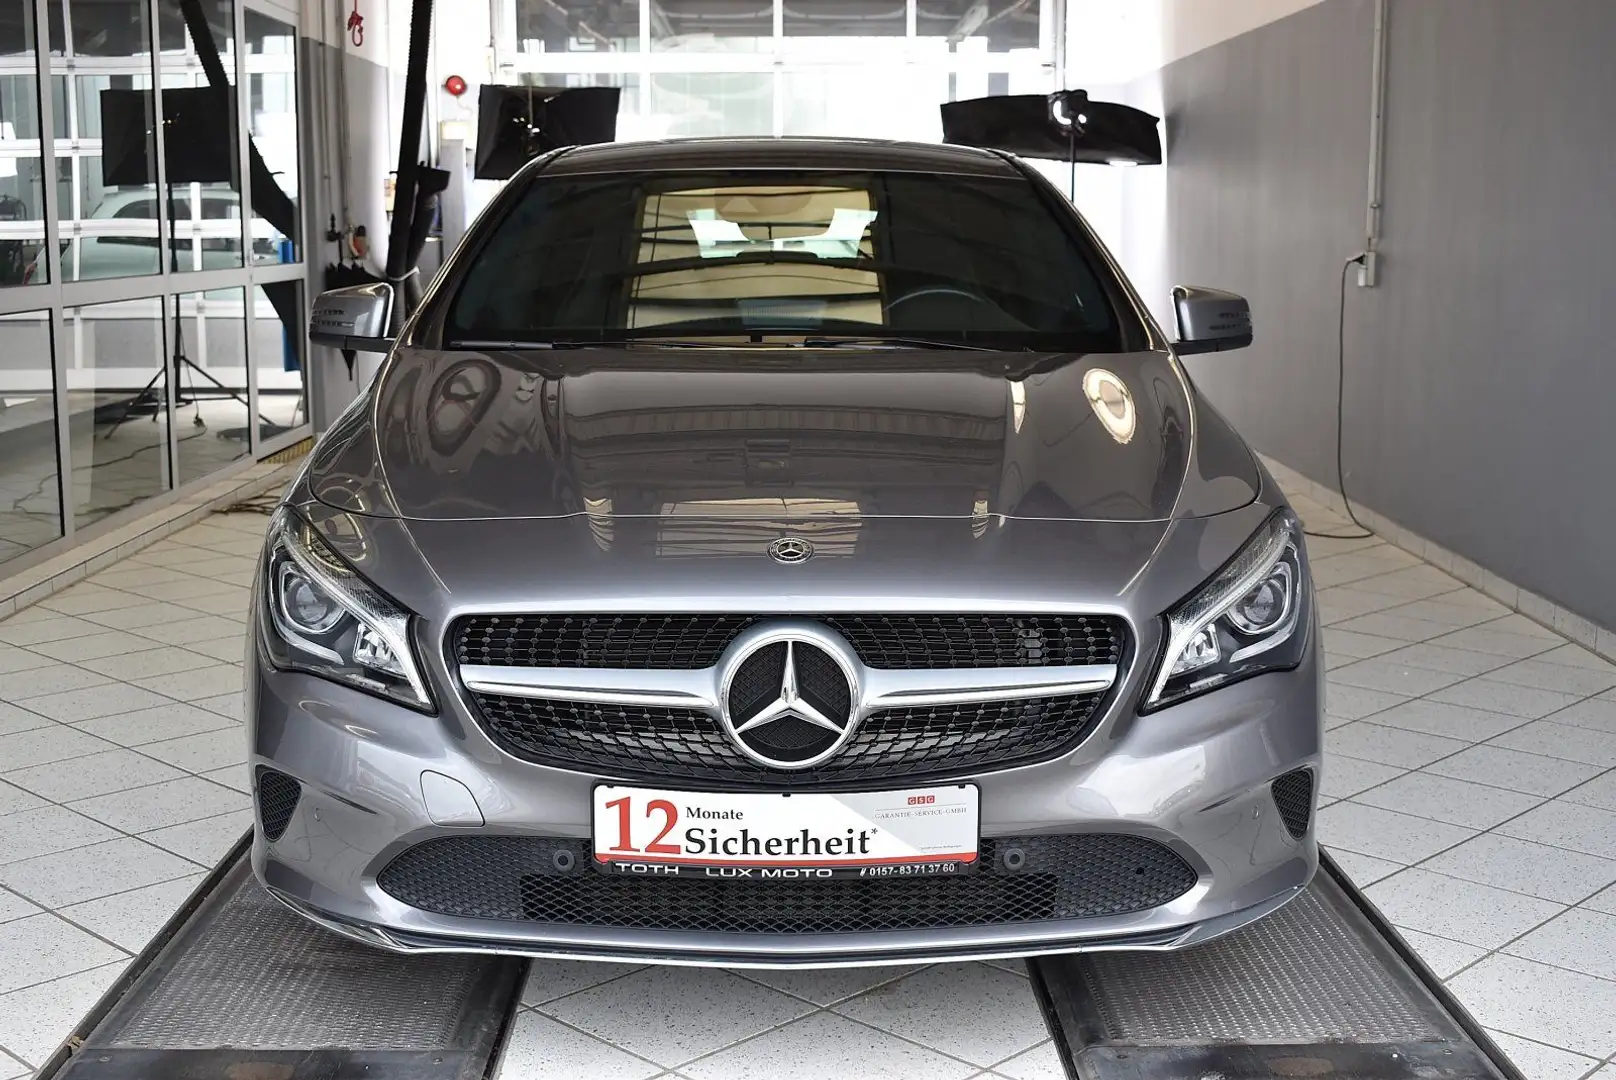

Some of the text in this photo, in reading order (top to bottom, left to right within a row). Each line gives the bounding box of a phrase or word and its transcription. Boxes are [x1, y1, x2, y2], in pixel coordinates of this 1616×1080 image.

[908, 795, 935, 805] GSG
[686, 806, 744, 820] Monate
[605, 796, 681, 854] 12
[615, 863, 833, 878] TOTH LUX MOTO
